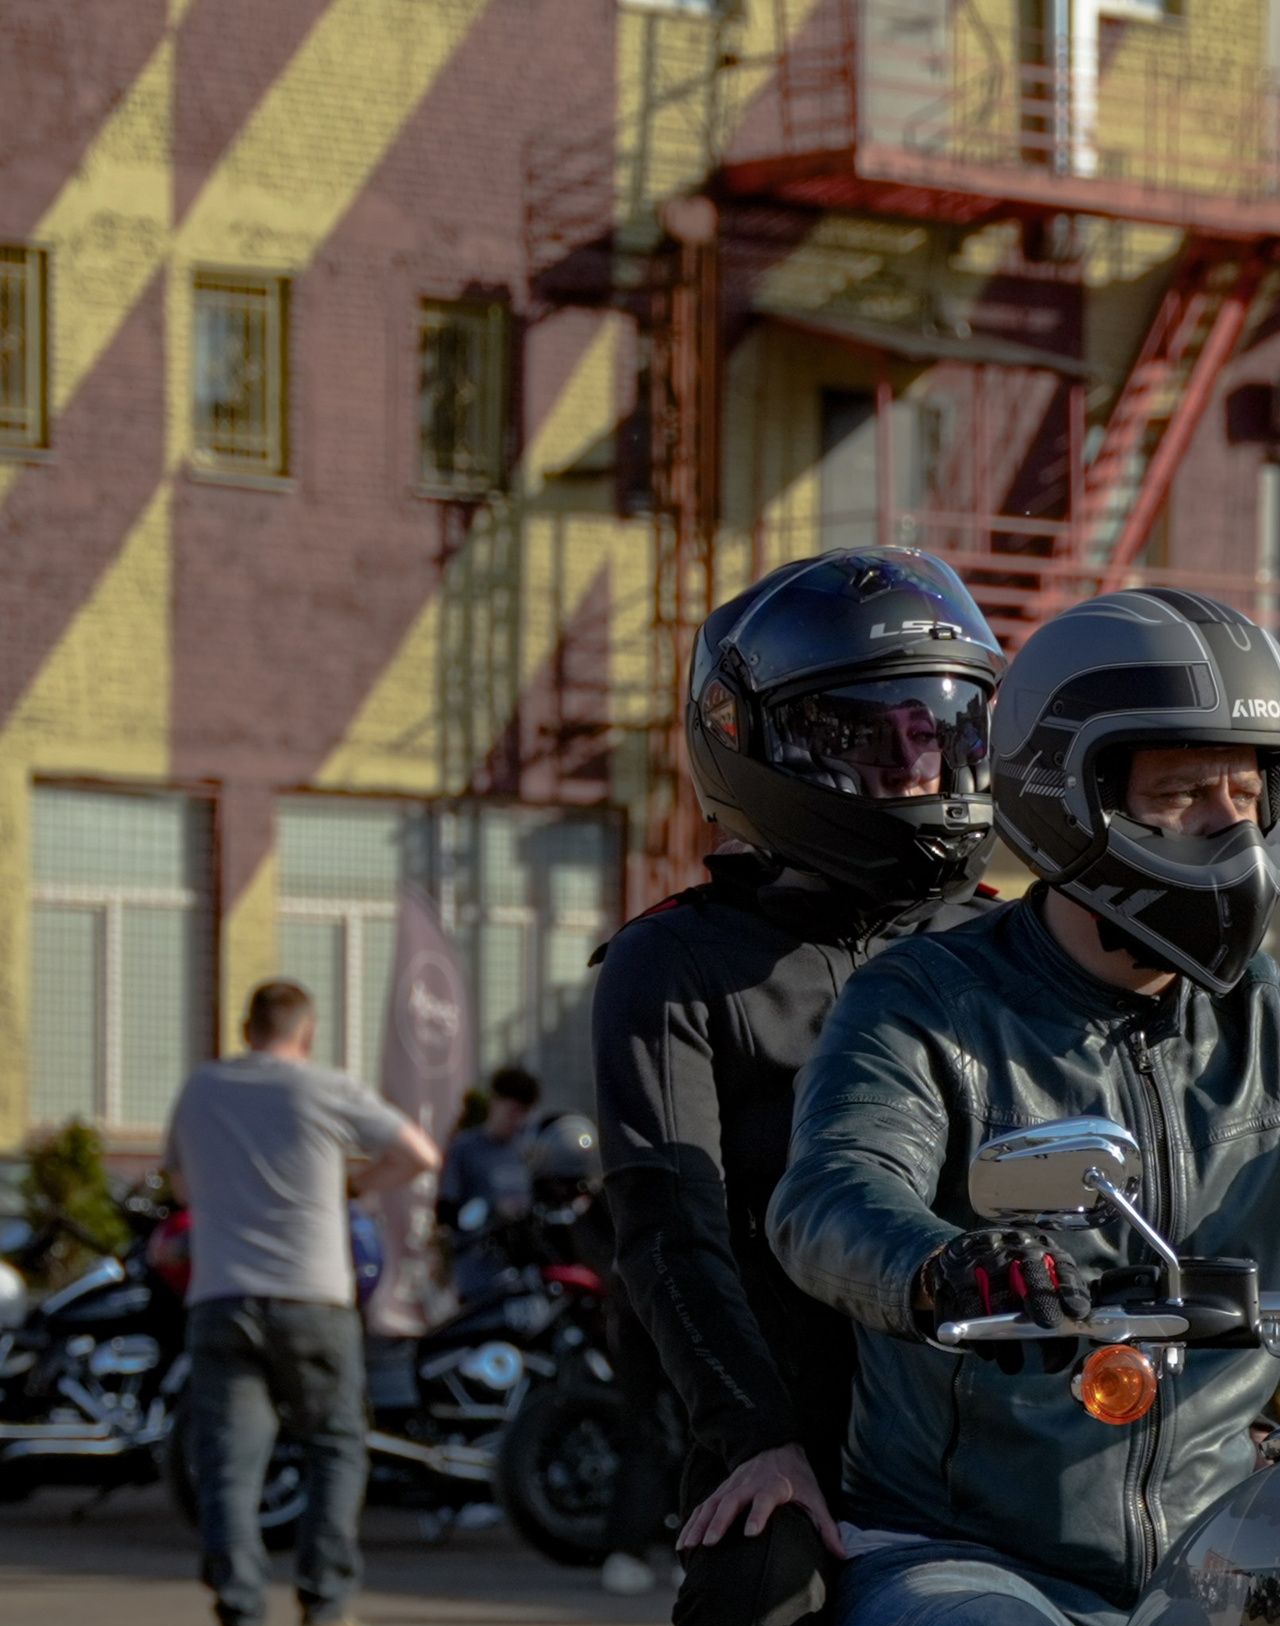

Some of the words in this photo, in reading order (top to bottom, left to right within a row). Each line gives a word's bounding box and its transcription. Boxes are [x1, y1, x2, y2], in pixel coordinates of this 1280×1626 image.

[648, 1230, 668, 1275] HITING
[664, 1276, 683, 1301] THE
[675, 1303, 705, 1344] LIMITS
